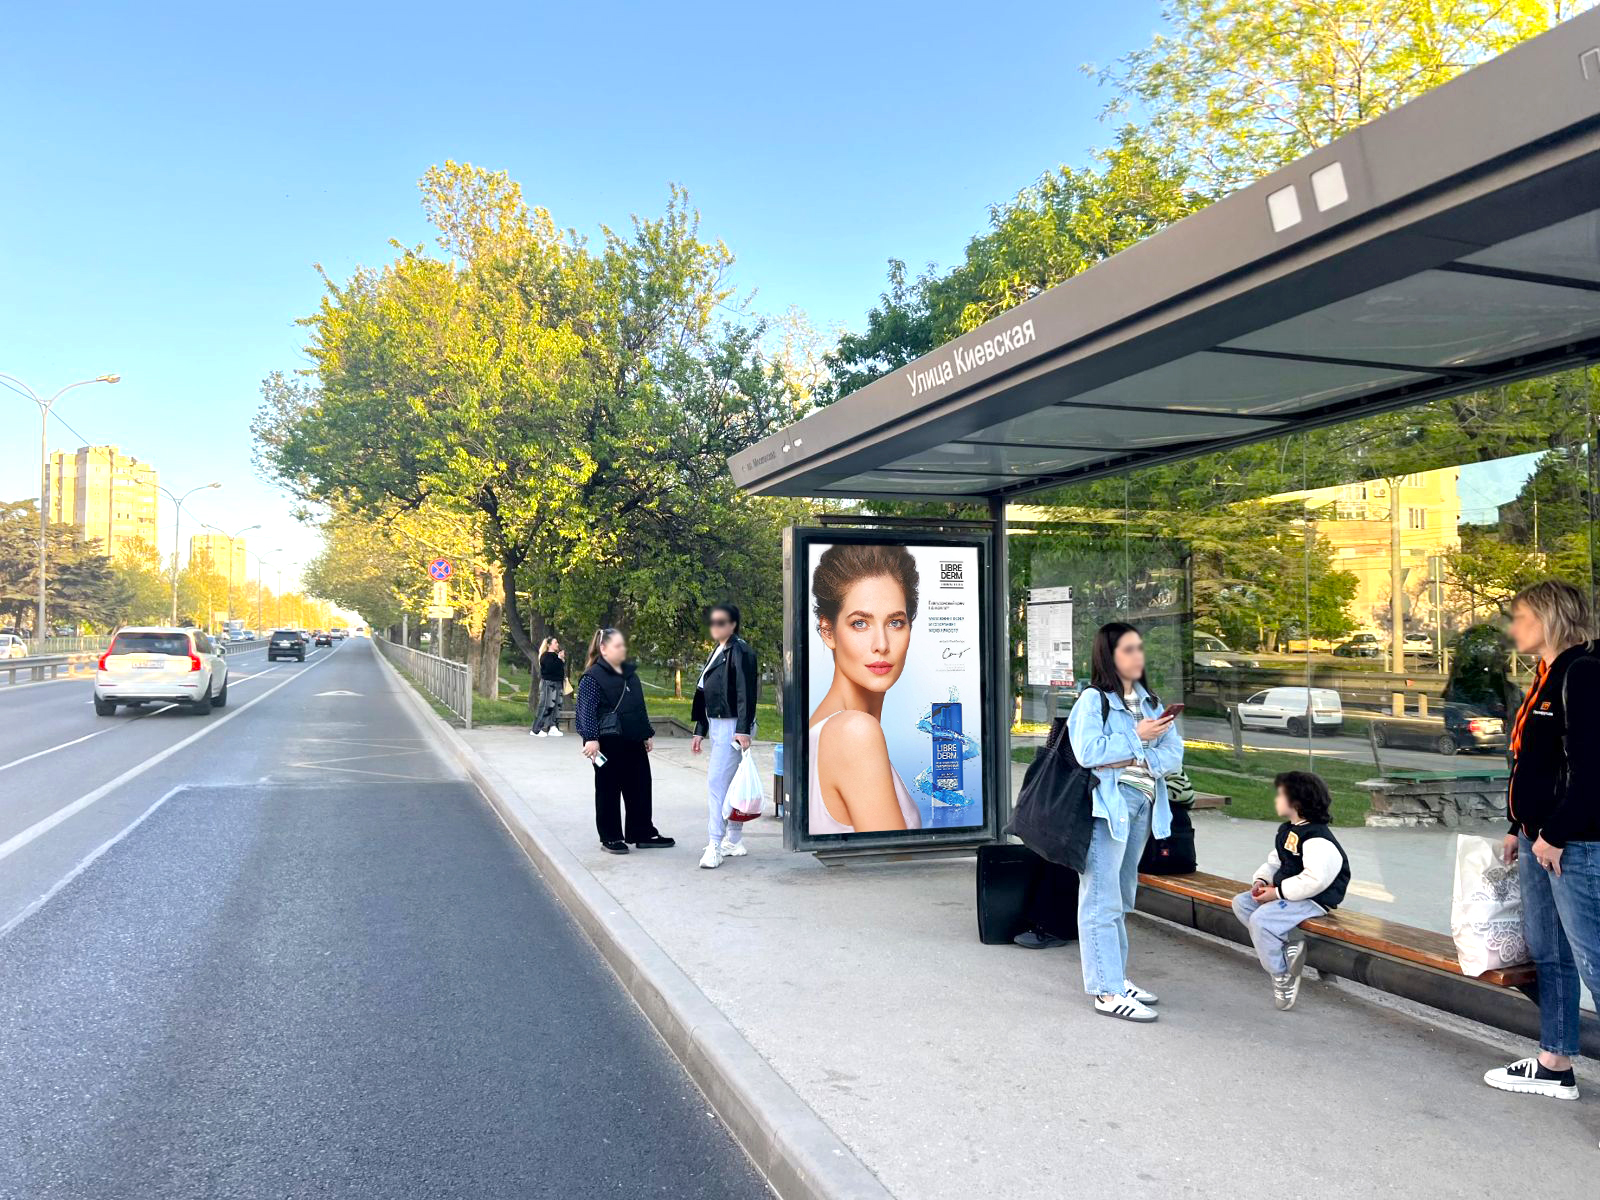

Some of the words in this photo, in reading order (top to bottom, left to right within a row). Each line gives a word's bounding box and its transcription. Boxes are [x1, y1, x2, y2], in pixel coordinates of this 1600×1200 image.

[906, 360, 954, 397] Улица
[953, 319, 1036, 375] Киевская
[940, 563, 963, 572] LIBRE
[940, 571, 963, 580] DERM
[937, 744, 957, 752] LIBRE
[1284, 831, 1299, 853] R
